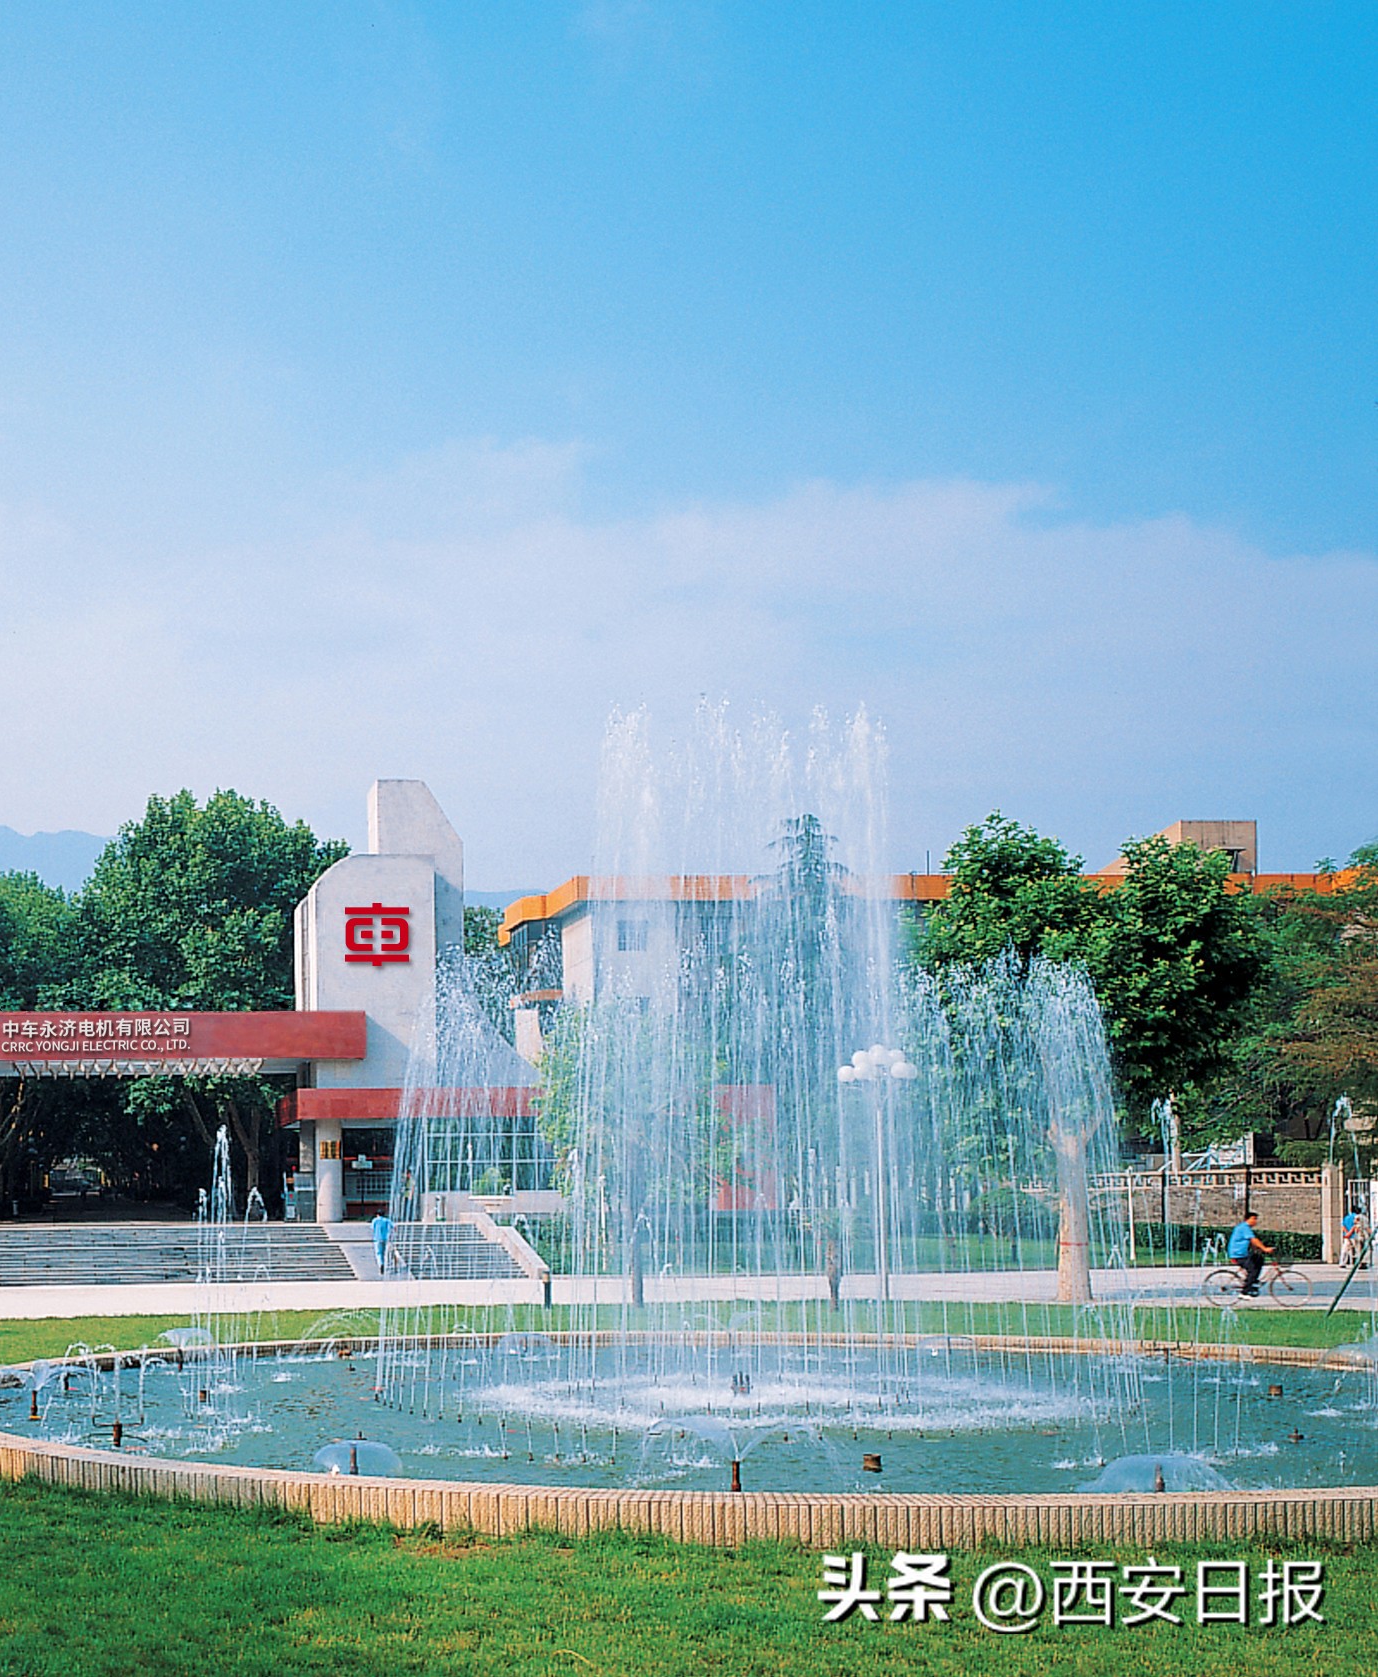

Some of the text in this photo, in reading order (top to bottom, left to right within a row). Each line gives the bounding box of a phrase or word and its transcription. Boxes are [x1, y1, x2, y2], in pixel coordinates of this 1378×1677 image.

[2, 1018, 190, 1038] 中车永济电机有限公司
[1, 1039, 191, 1052] CRRC YONGJI ELECTRIC CO., LTD.
